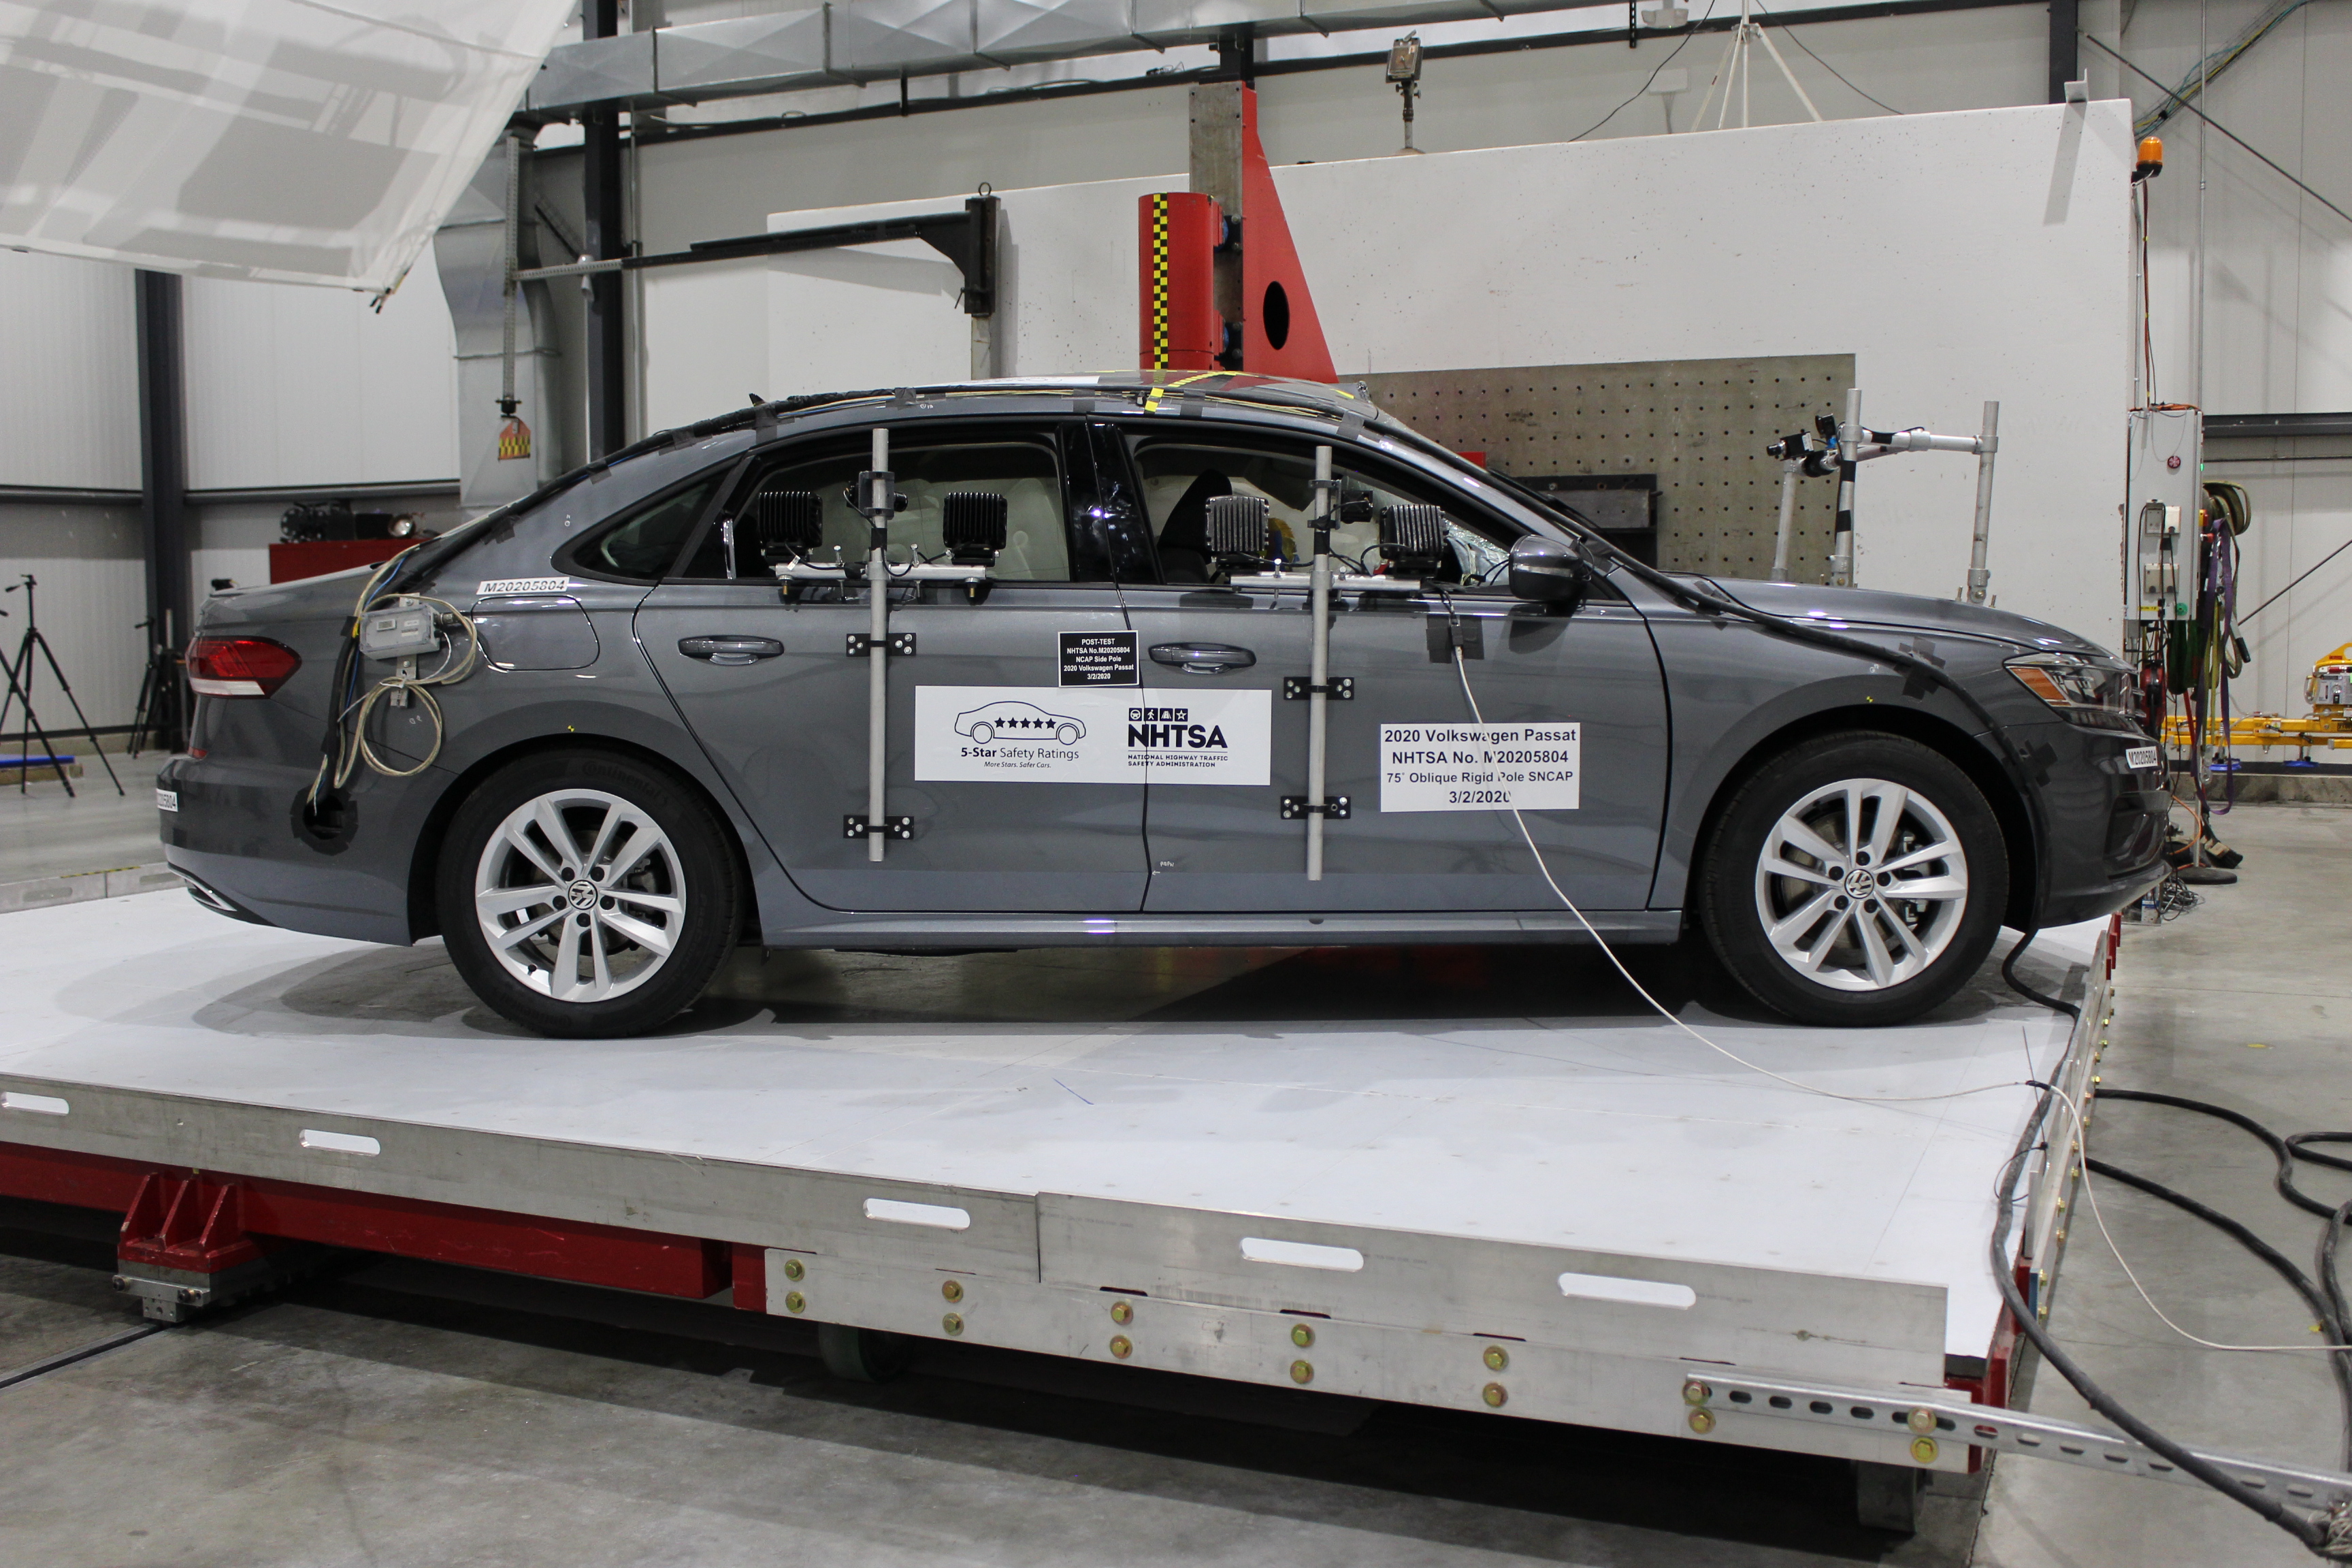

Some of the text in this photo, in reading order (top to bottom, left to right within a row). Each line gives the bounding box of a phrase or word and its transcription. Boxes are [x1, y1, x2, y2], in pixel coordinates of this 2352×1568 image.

[484, 580, 566, 593] M20205804
[1079, 664, 1113, 672] Volkswagen
[1128, 723, 1228, 749] NHTSA
[1384, 728, 1577, 745] 2020 Volkswagen Passat
[960, 747, 1079, 762] 5-Star Safety Ratings
[1392, 750, 1569, 764] NHTSA No. M20205804
[1409, 772, 1458, 785] Oblique
[1461, 771, 1494, 785] Rigid
[1498, 771, 1524, 782] Pole
[1528, 771, 1573, 781] SNCAP
[1448, 790, 1512, 804] 3/2/2020
